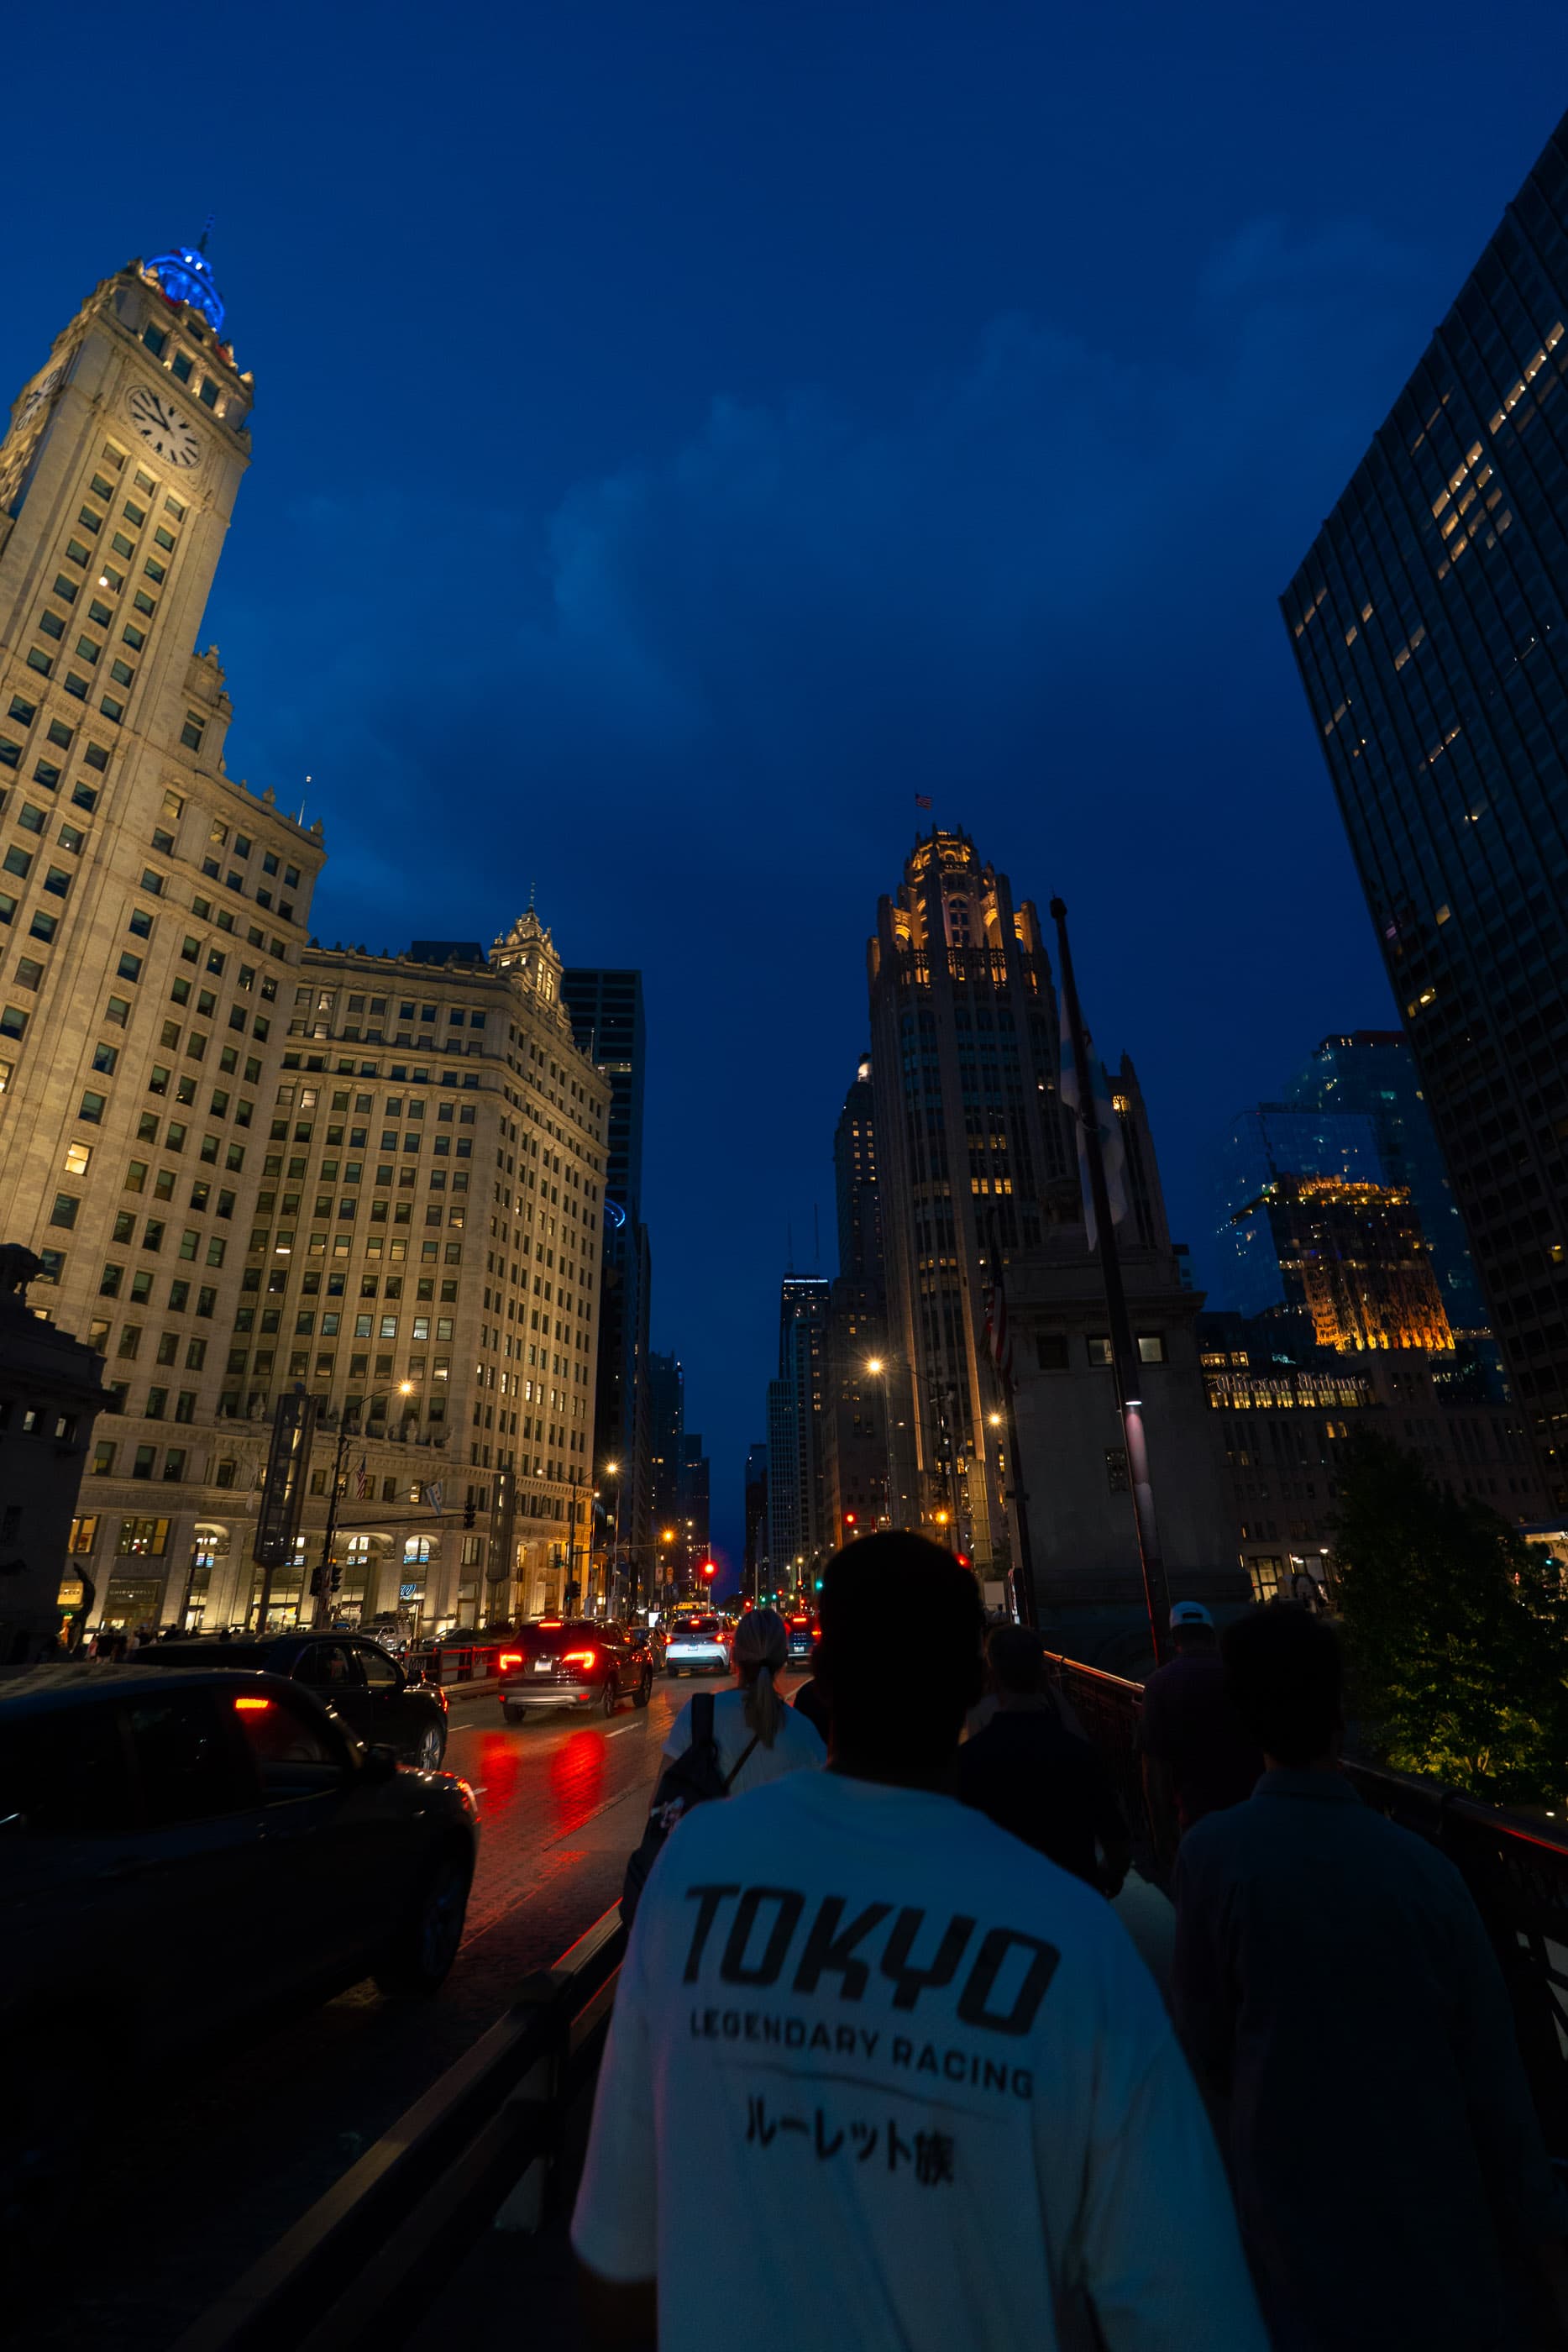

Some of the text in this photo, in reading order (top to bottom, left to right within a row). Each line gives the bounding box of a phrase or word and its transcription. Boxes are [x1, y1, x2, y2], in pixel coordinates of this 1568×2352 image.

[683, 1883, 1062, 2036] TOKYO
[690, 2008, 1034, 2100] LEGENDARY RACING
